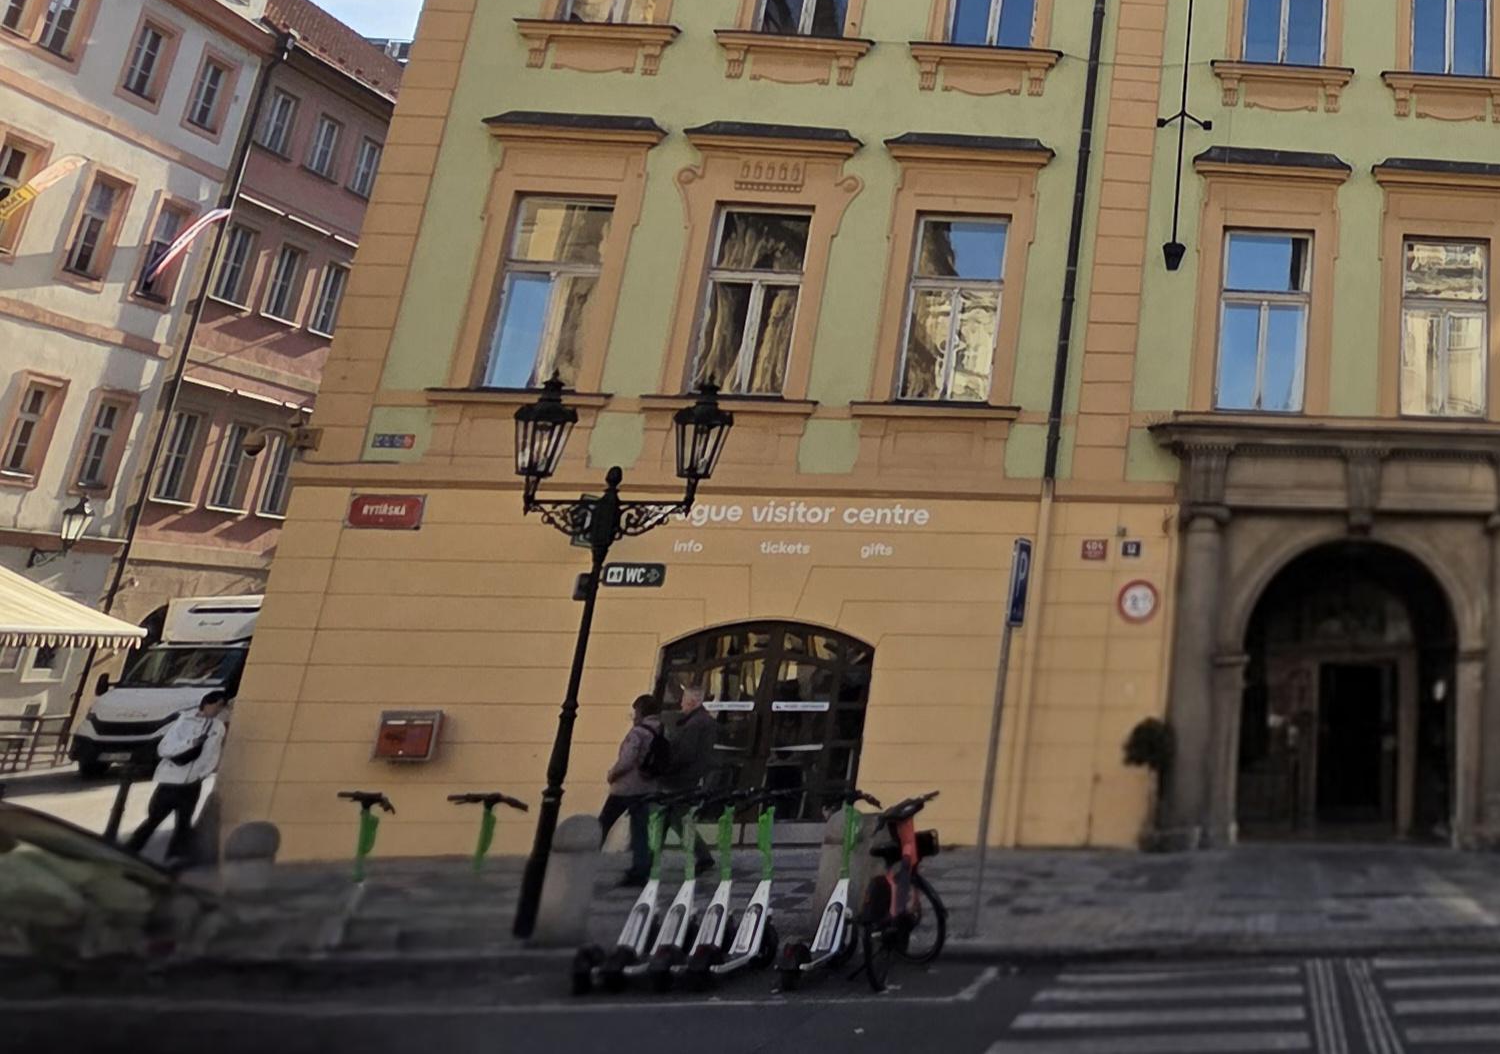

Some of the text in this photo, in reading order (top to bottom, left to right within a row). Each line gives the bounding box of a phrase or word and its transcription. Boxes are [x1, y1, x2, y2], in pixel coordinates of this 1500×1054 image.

[752, 499, 836, 524] visitor
[842, 503, 930, 525] centre
[673, 539, 704, 553] info
[760, 540, 811, 555] tickets
[860, 542, 894, 559] gifts
[625, 567, 647, 583] WC
[1015, 551, 1029, 598] P
